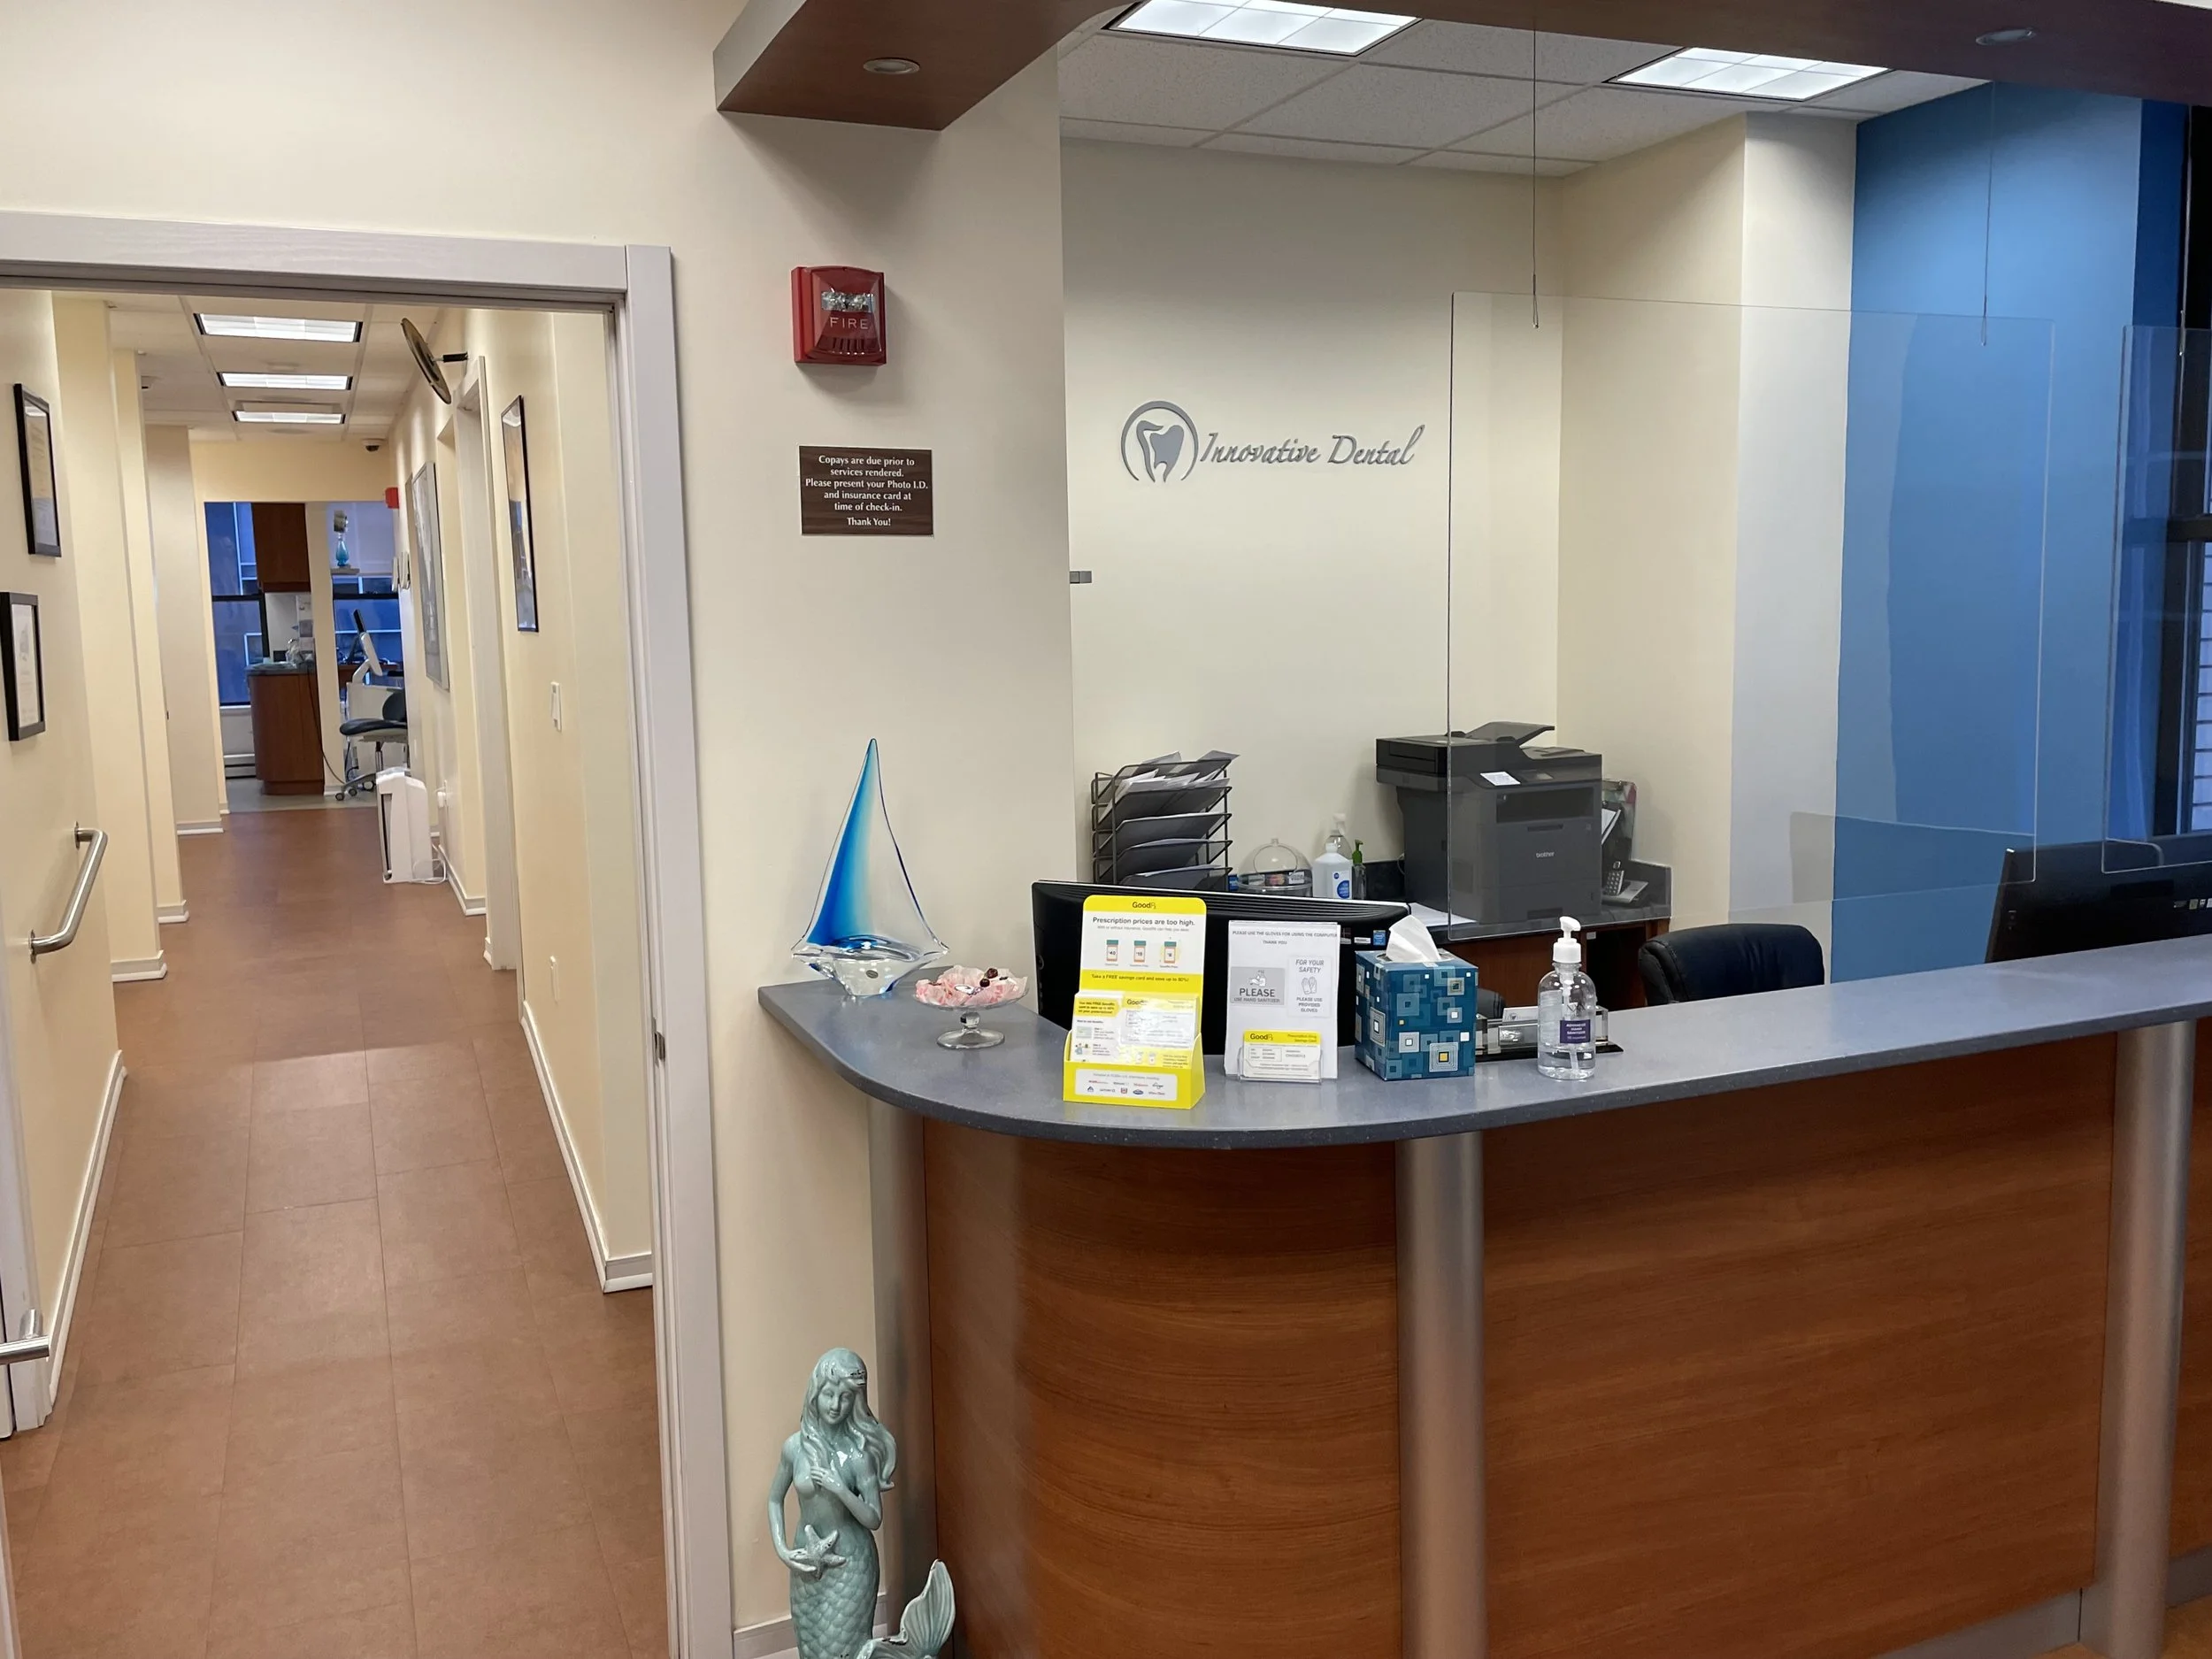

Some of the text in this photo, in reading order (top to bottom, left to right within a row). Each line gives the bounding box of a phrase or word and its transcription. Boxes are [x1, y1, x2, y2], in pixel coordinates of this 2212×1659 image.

[829, 317, 870, 330] FIRE
[1200, 424, 1426, 465] Innovative Dental
[818, 455, 849, 466] Copays
[866, 456, 882, 465] due
[884, 457, 904, 467] prior
[865, 468, 904, 477] rendered.
[805, 478, 928, 490] Please present your Photo I.D.
[824, 490, 840, 499] and
[841, 490, 881, 500] insurance
[883, 491, 902, 501] card
[834, 502, 903, 511] time of check-in.
[847, 517, 891, 526] Thank You!
[1092, 917, 1132, 926] Prescription
[1133, 918, 1153, 926] prices
[1239, 987, 1276, 997] PLEASE
